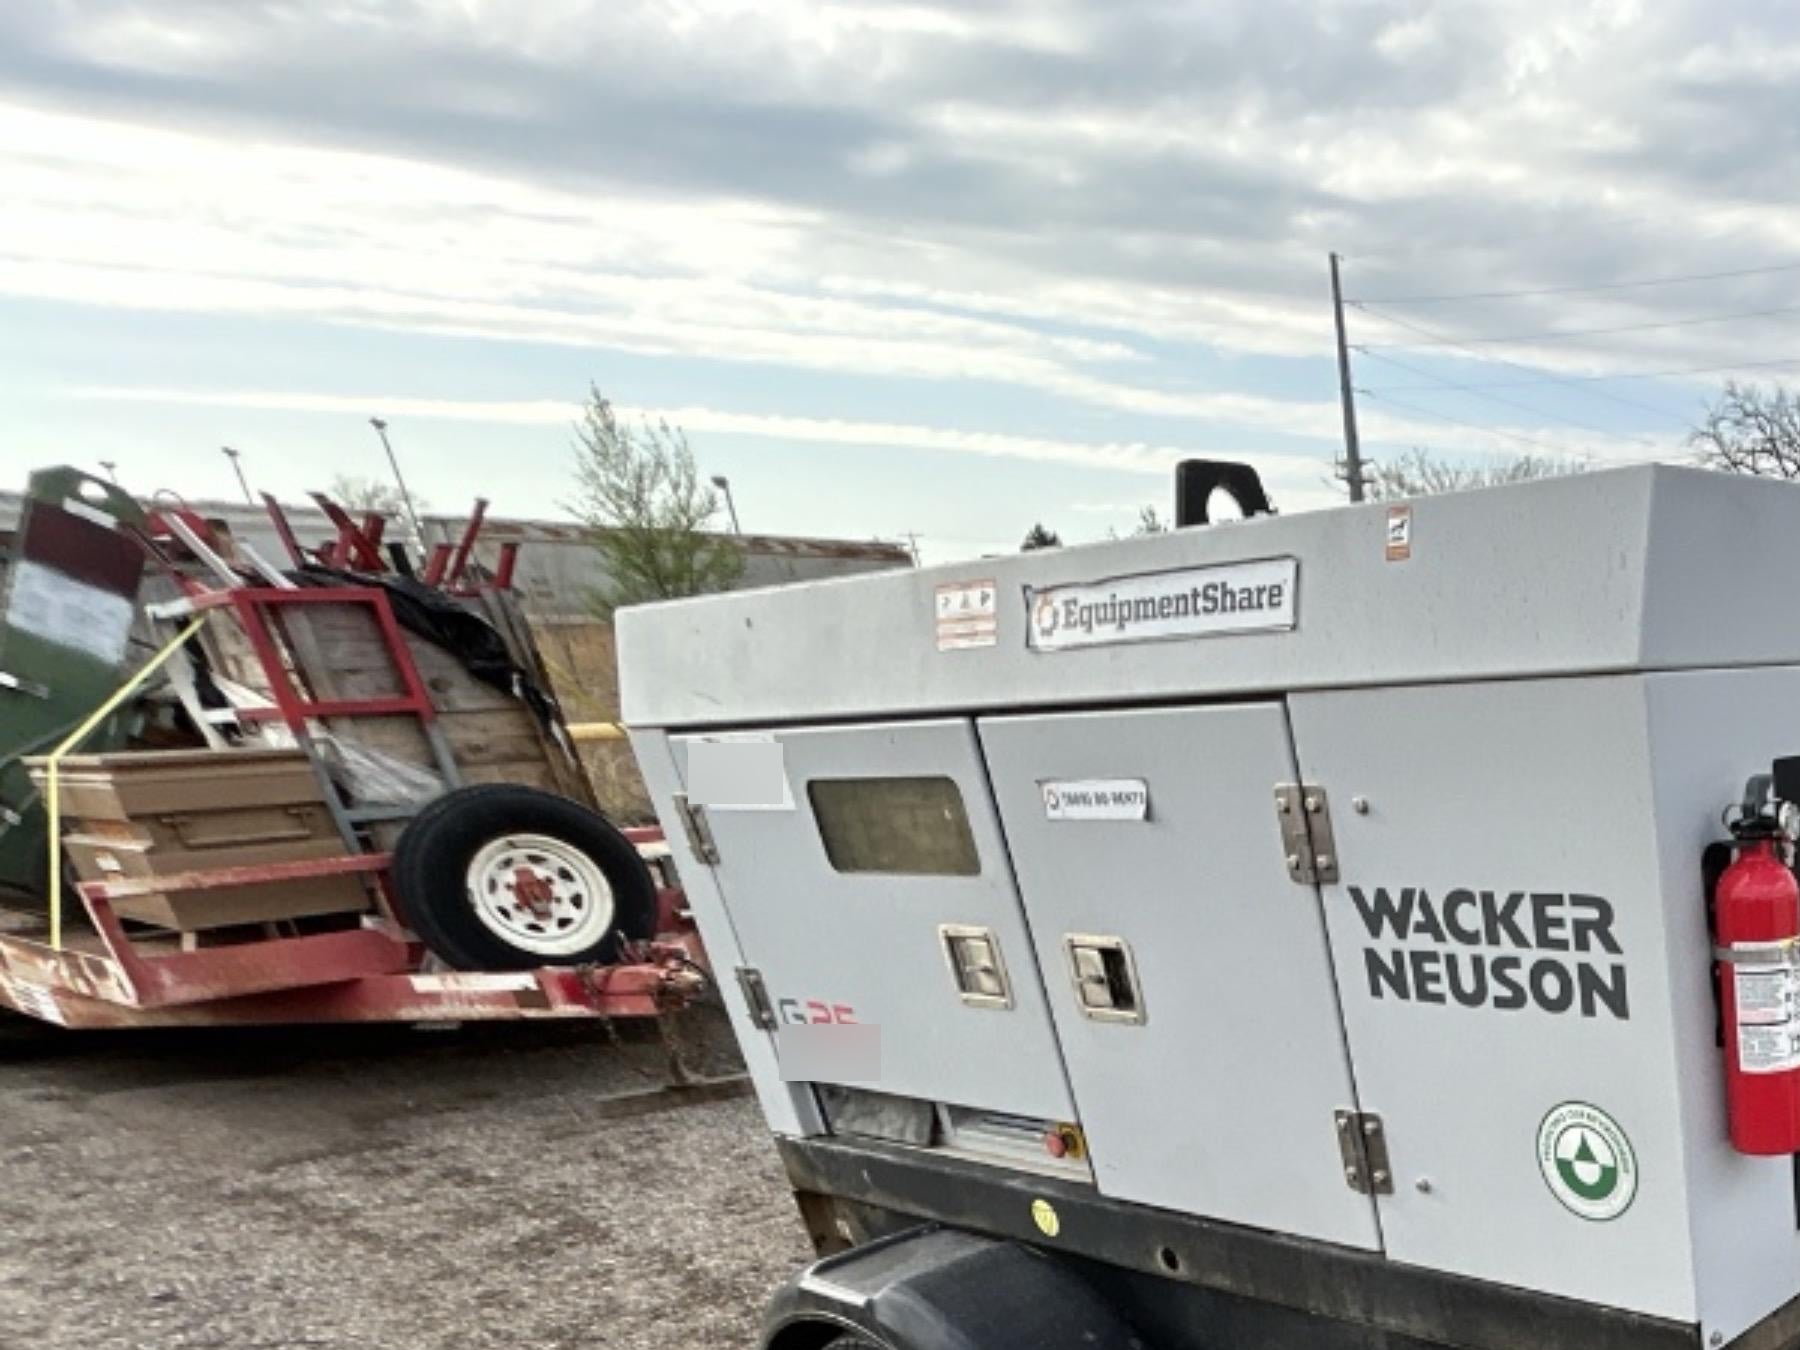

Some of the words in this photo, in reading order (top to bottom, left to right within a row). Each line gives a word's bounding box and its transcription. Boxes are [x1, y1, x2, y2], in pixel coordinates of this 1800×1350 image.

[1061, 581, 1283, 634] EquipmentShare
[1346, 885, 1625, 955] WACKER
[1362, 946, 1631, 1021] NEUSON
